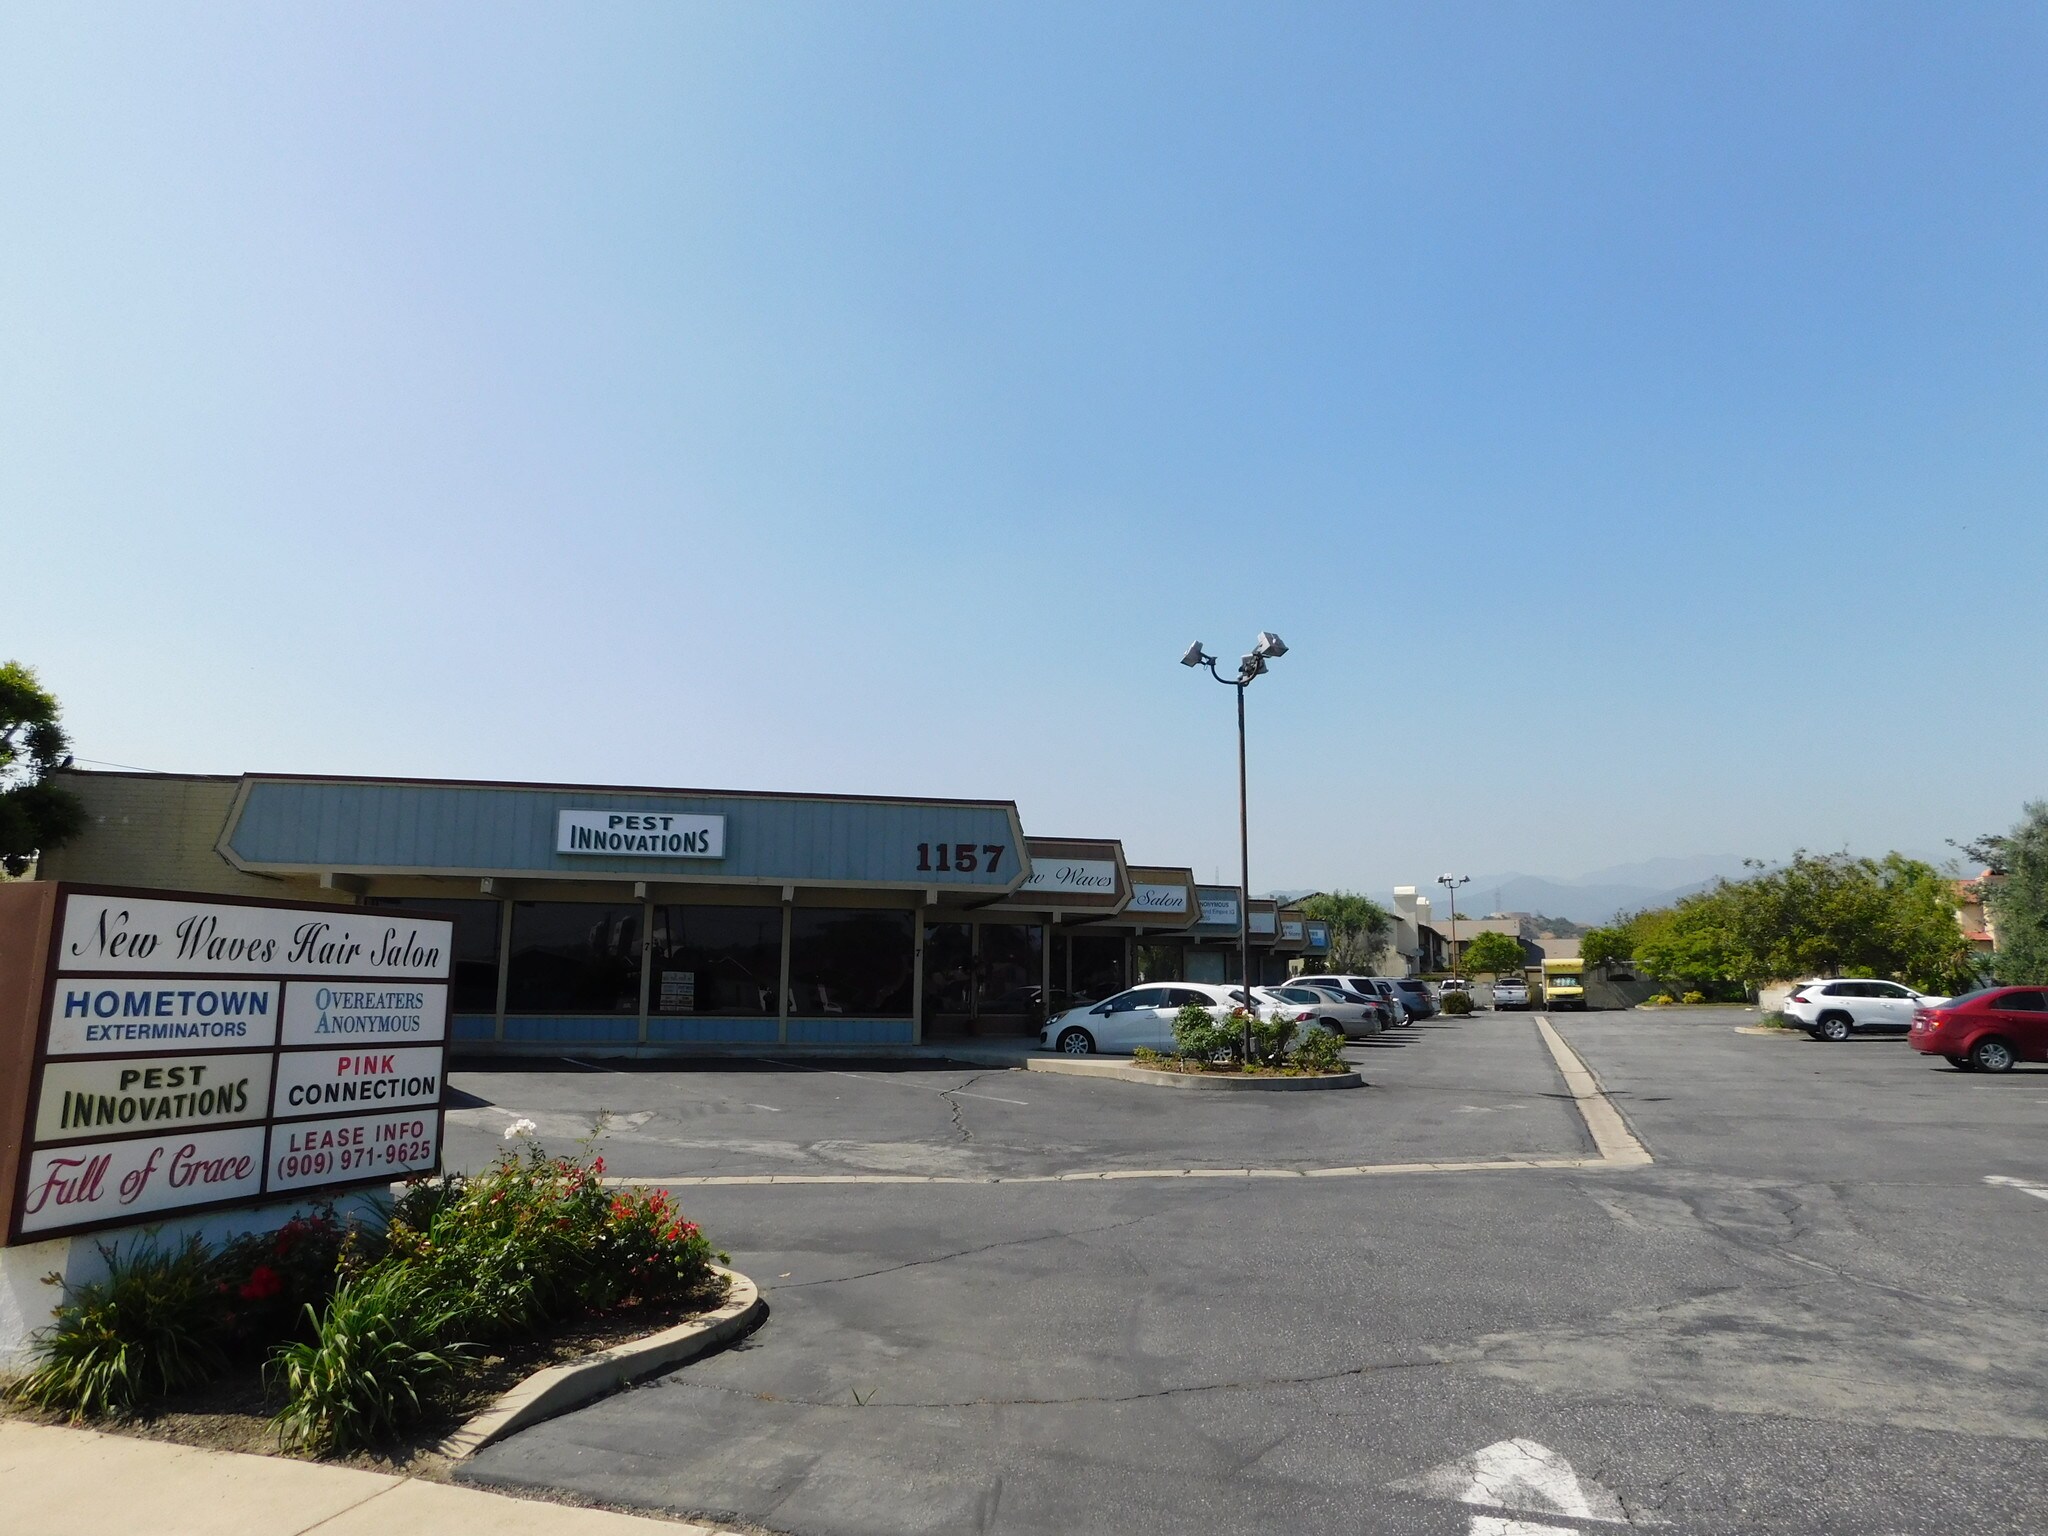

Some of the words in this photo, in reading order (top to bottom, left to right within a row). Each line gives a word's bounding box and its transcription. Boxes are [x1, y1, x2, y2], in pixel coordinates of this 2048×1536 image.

[608, 815, 675, 832] PEST
[570, 824, 710, 854] INNOVATIONS
[916, 843, 1005, 873] 1157
[1055, 867, 1113, 887] Waves
[1136, 889, 1184, 907] Salon
[72, 908, 162, 958] New
[176, 914, 278, 963] Waves
[288, 922, 362, 966] Hair
[370, 927, 440, 969] Salon
[64, 990, 269, 1018] HOMETOWN
[315, 987, 424, 1012] OVEREATERS
[85, 1022, 247, 1042] EXTERMINATORS
[314, 1011, 420, 1035] ANONYMOUS
[119, 1065, 207, 1091] PEST
[337, 1055, 395, 1077] PINK
[60, 1078, 249, 1130] INNOVATIONS
[288, 1075, 436, 1107] CONNECTION
[289, 1126, 365, 1153] LEASE
[375, 1120, 425, 1143] INFO
[277, 1150, 334, 1183] (909)
[340, 1141, 431, 1169] 971-9625
[25, 1153, 113, 1215] Full
[119, 1146, 166, 1205] of
[168, 1143, 257, 1190] Grace
